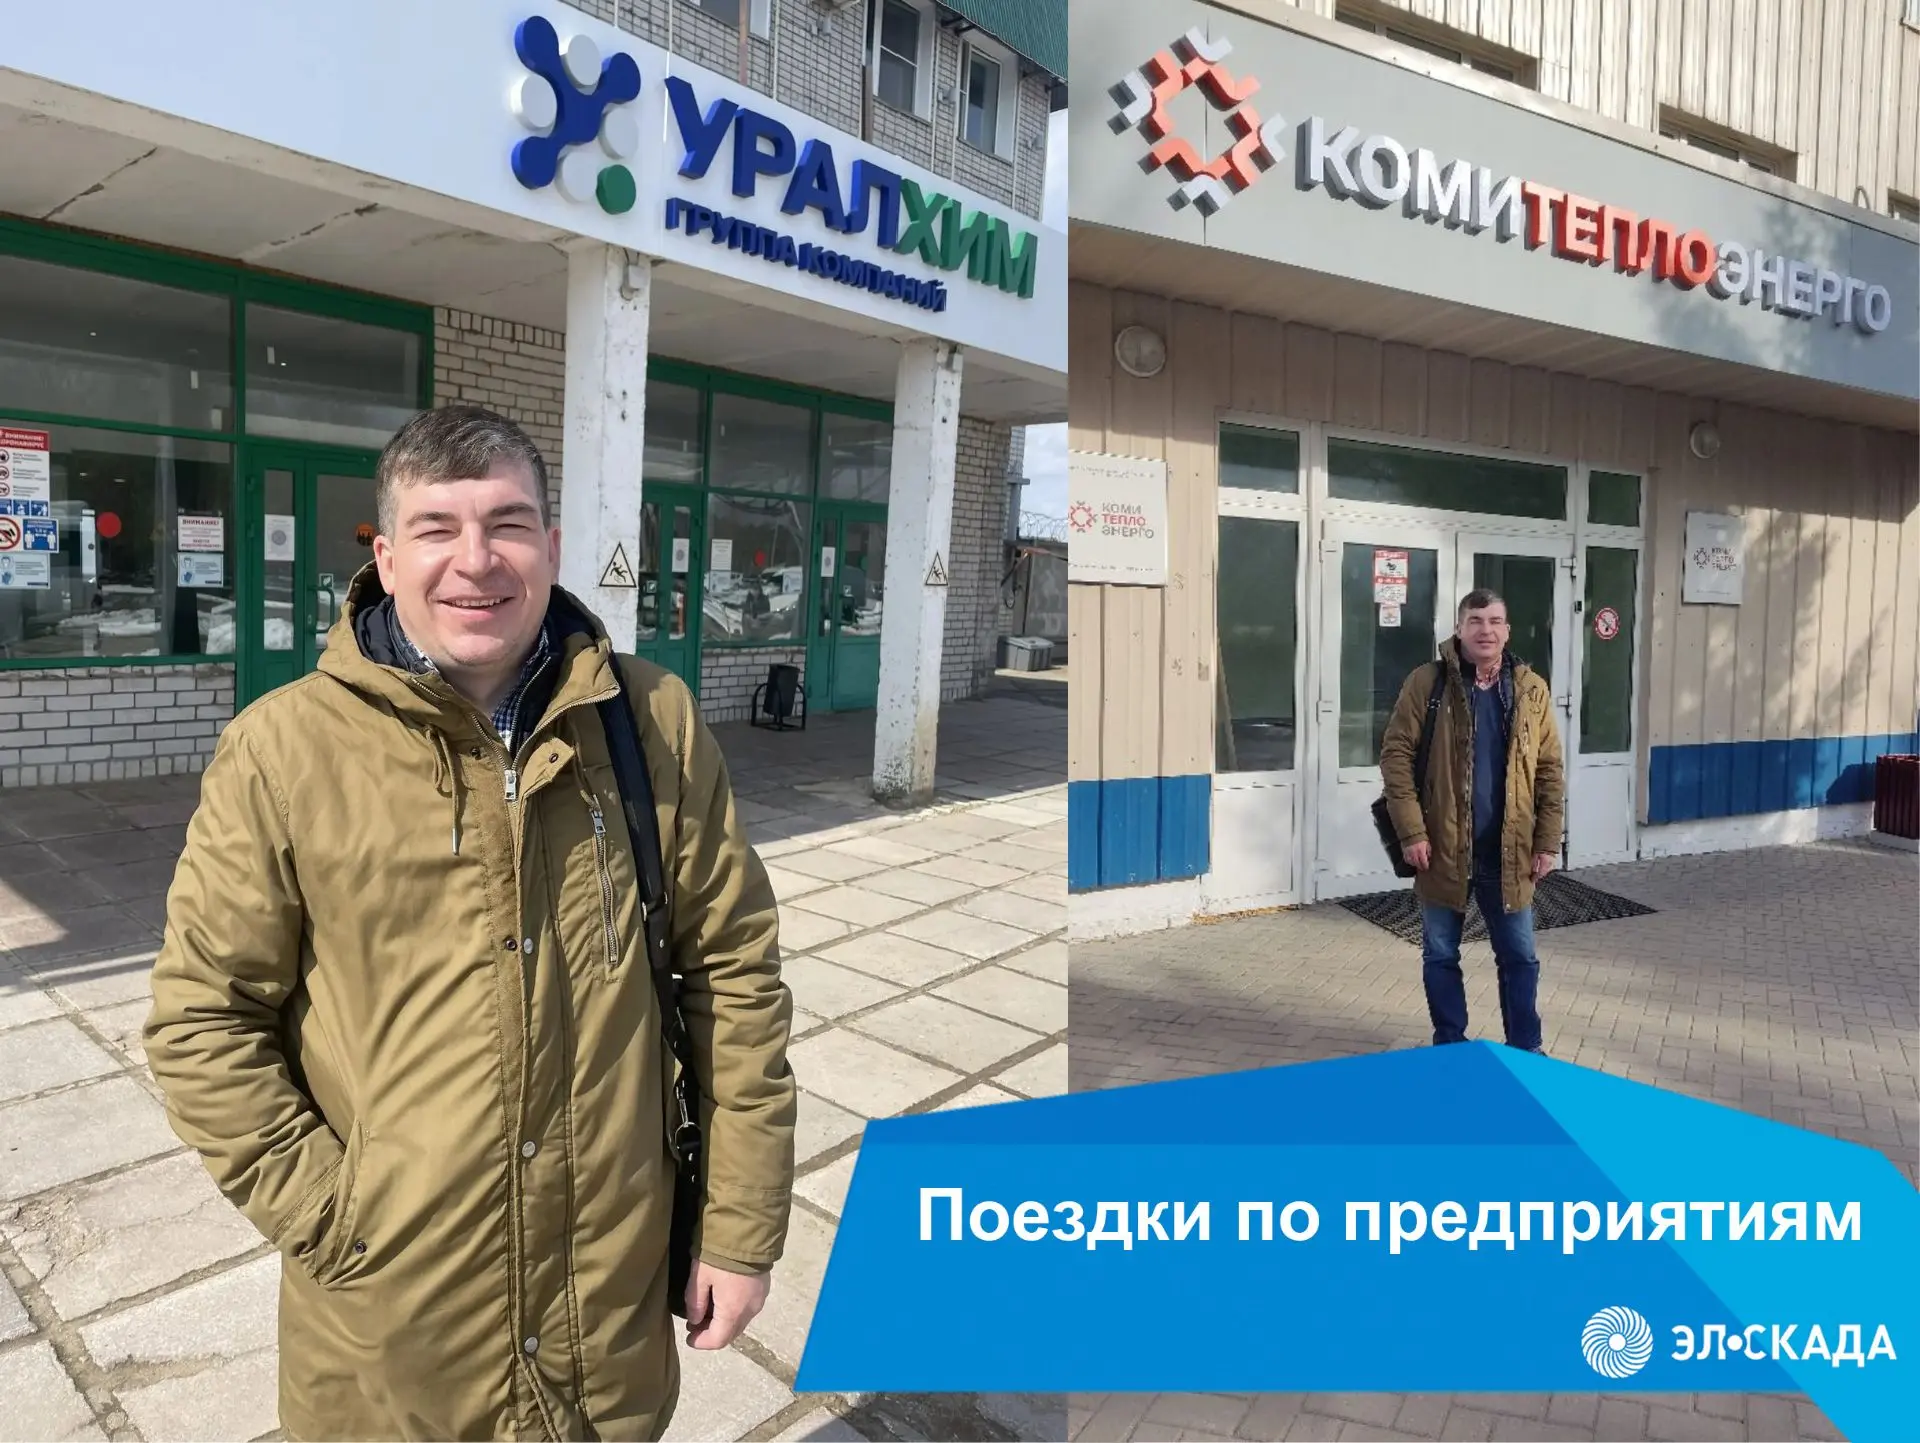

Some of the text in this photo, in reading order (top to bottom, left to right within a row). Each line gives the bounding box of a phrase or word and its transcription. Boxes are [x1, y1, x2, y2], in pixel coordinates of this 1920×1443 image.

[664, 75, 1037, 299] УРАЛХИМ
[1296, 115, 1893, 334] КОМИТЕПЛОЭНЕРГО
[665, 197, 947, 313] ГРУППА КОМПАНИЙ
[0, 438, 44, 448] ОРОНАВИРУС
[1102, 502, 1142, 514] КОМИ
[1102, 513, 1146, 526] ТЕПЛО
[1102, 525, 1155, 539] ЭНЕРГО
